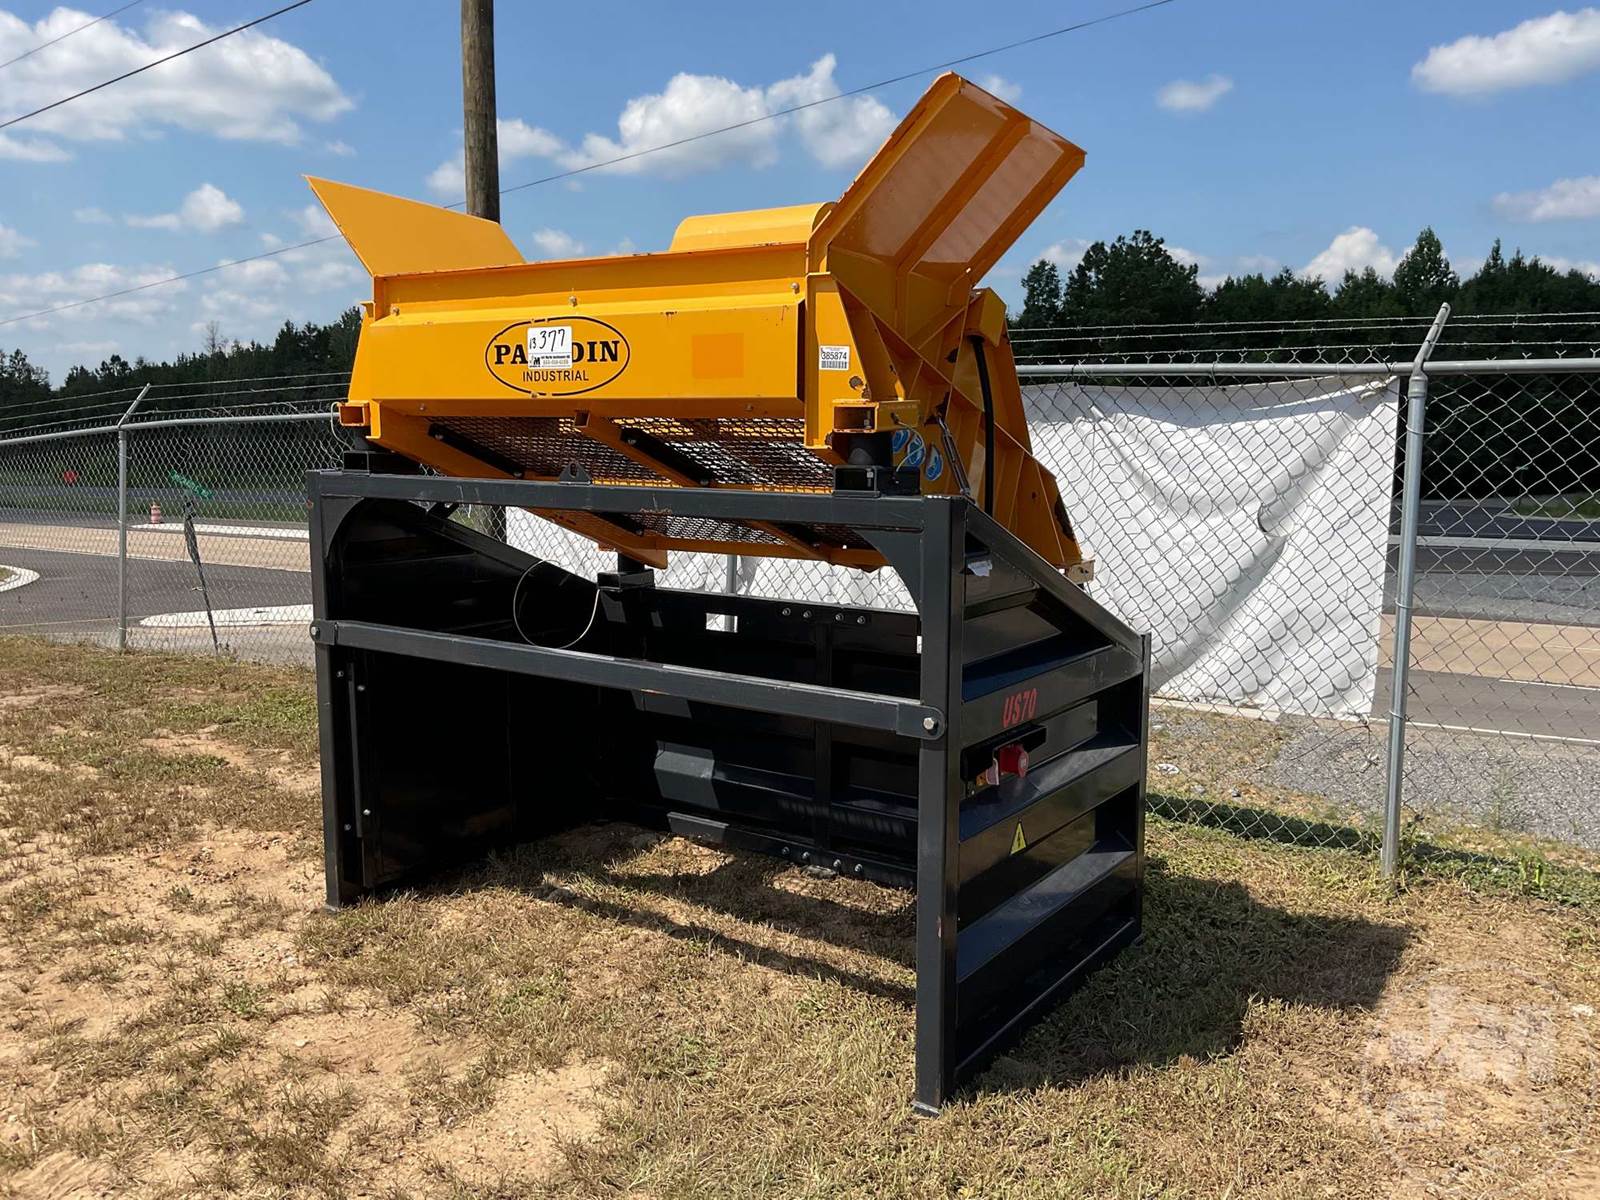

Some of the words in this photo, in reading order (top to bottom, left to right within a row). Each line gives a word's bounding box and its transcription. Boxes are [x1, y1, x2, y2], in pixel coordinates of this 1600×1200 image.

[539, 328, 566, 352] 377
[494, 340, 620, 365] PADIN
[821, 351, 847, 360] 385874
[523, 370, 589, 382] INDUSTRIAL
[1003, 688, 1038, 728] US70
